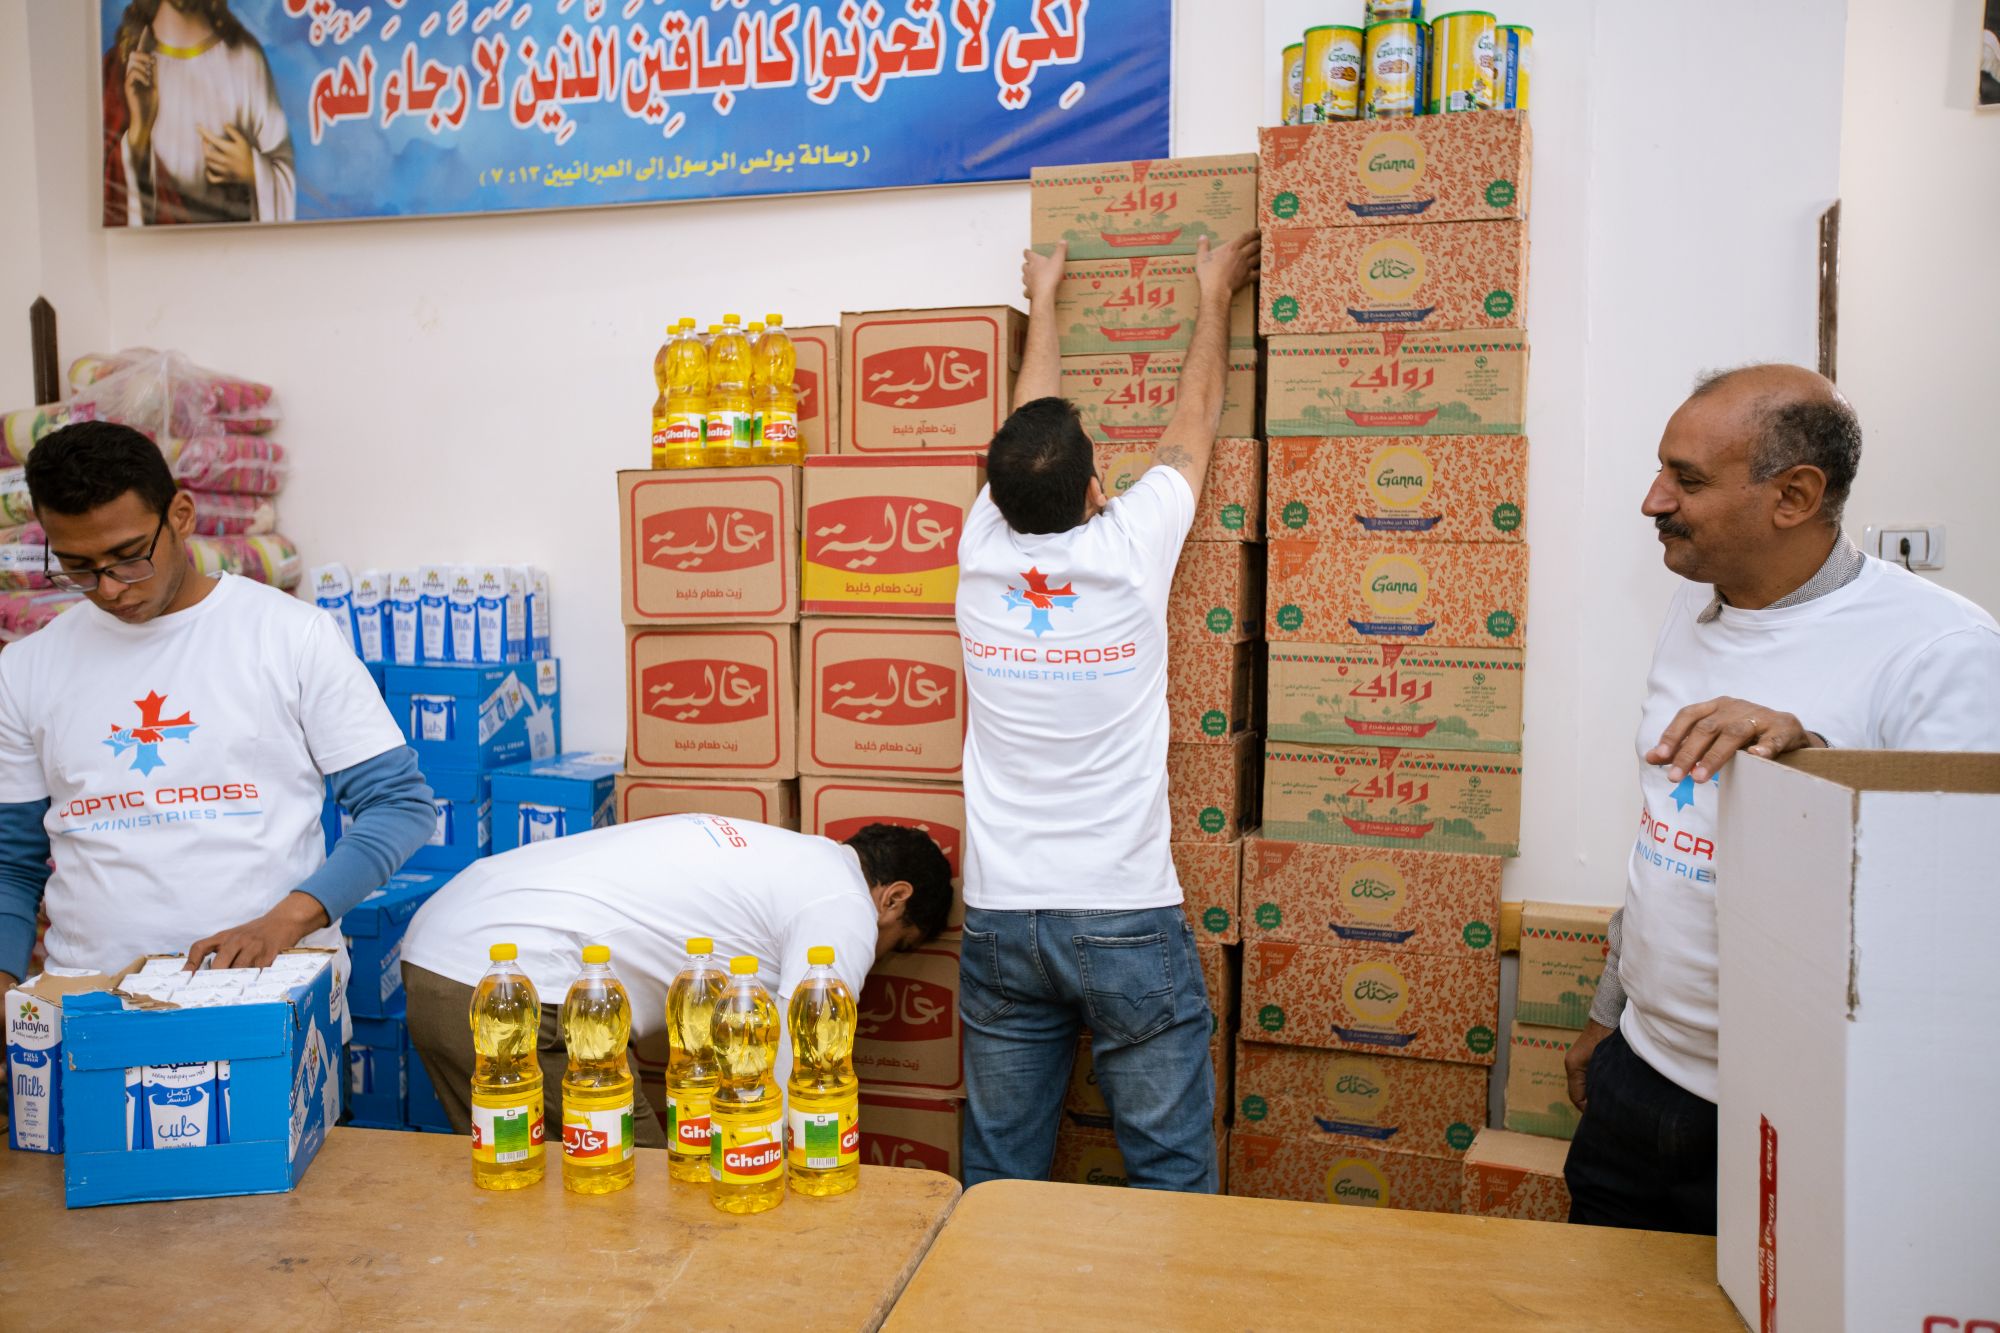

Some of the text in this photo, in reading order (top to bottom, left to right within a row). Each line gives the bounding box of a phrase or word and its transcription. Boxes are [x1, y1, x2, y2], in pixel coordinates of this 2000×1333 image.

[667, 152, 736, 179] الرسول
[740, 148, 795, 174] بولس
[1368, 153, 1415, 172] Ganna
[868, 350, 981, 406] غالية
[892, 424, 914, 435] خليط
[1376, 468, 1423, 488] Ganna
[649, 510, 767, 570] غالية
[814, 502, 954, 570] غالية
[676, 587, 743, 600] زيت طعام خليط
[844, 581, 923, 597] زيت طعام خليط
[1371, 575, 1418, 594] Ganna
[965, 637, 1137, 664] COPTIC CROSS
[986, 666, 1098, 681] MINISTRIES
[649, 664, 762, 721] غالية
[828, 664, 950, 721] غالية
[674, 738, 738, 752] زيت طعام خليط
[854, 740, 922, 755] زيت طعام خليط
[155, 783, 259, 806] CROSS
[90, 808, 217, 833] MINISTRIES
[857, 981, 946, 1035] غالي
[16, 1074, 46, 1098] Milk
[166, 1088, 191, 1098] كامل
[166, 1095, 191, 1104] الدسم
[158, 1114, 201, 1142] حليب
[562, 1130, 604, 1154] غالي
[725, 1148, 781, 1168] Ghalia
[1334, 1178, 1380, 1202] Ganna
